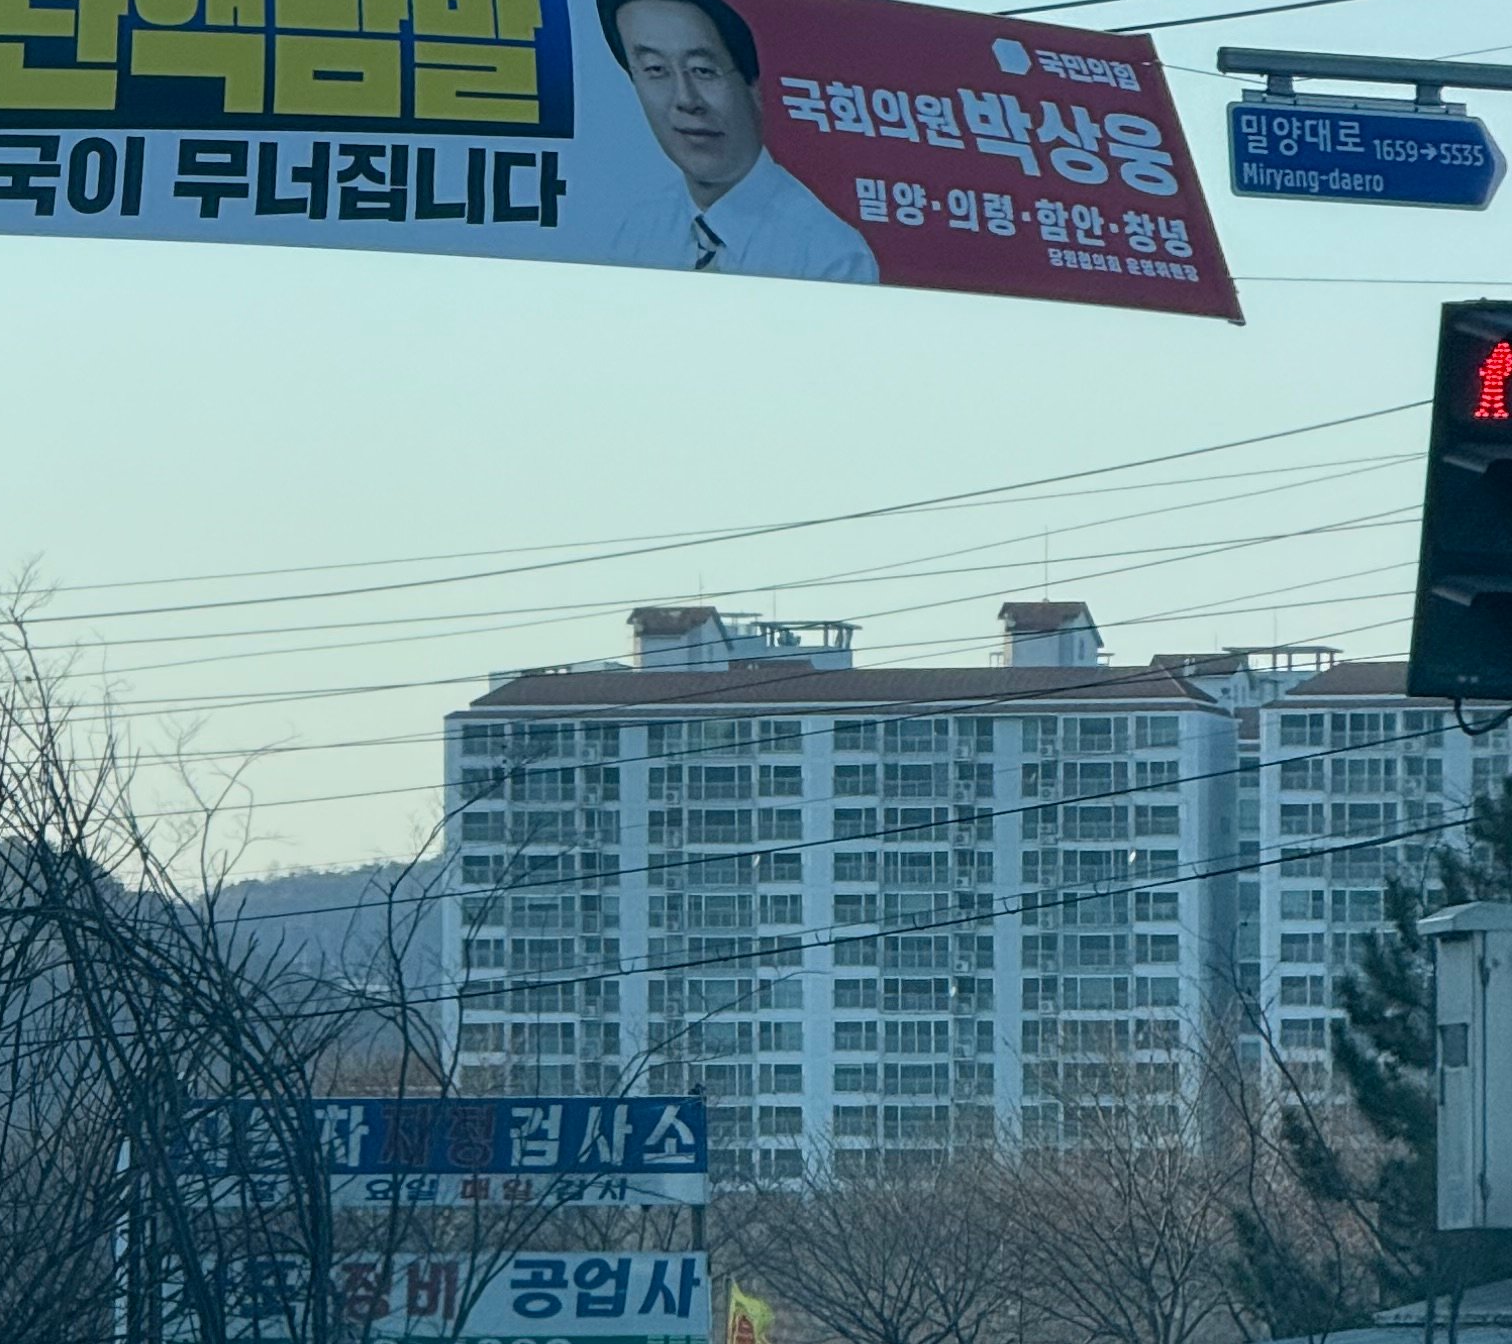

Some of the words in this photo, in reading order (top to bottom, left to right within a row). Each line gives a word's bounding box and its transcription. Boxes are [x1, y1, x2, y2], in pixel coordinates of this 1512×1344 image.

[1034, 48, 1142, 93] 국민의힘
[780, 76, 966, 150] 국회의원
[957, 87, 1180, 197] 박상웅
[1241, 114, 1365, 156] 밀양대로
[173, 138, 566, 227] 무너집니다
[1242, 162, 1384, 193] Miryang-daero
[509, 1103, 697, 1167] 검사소
[509, 1257, 700, 1319] 공업사
